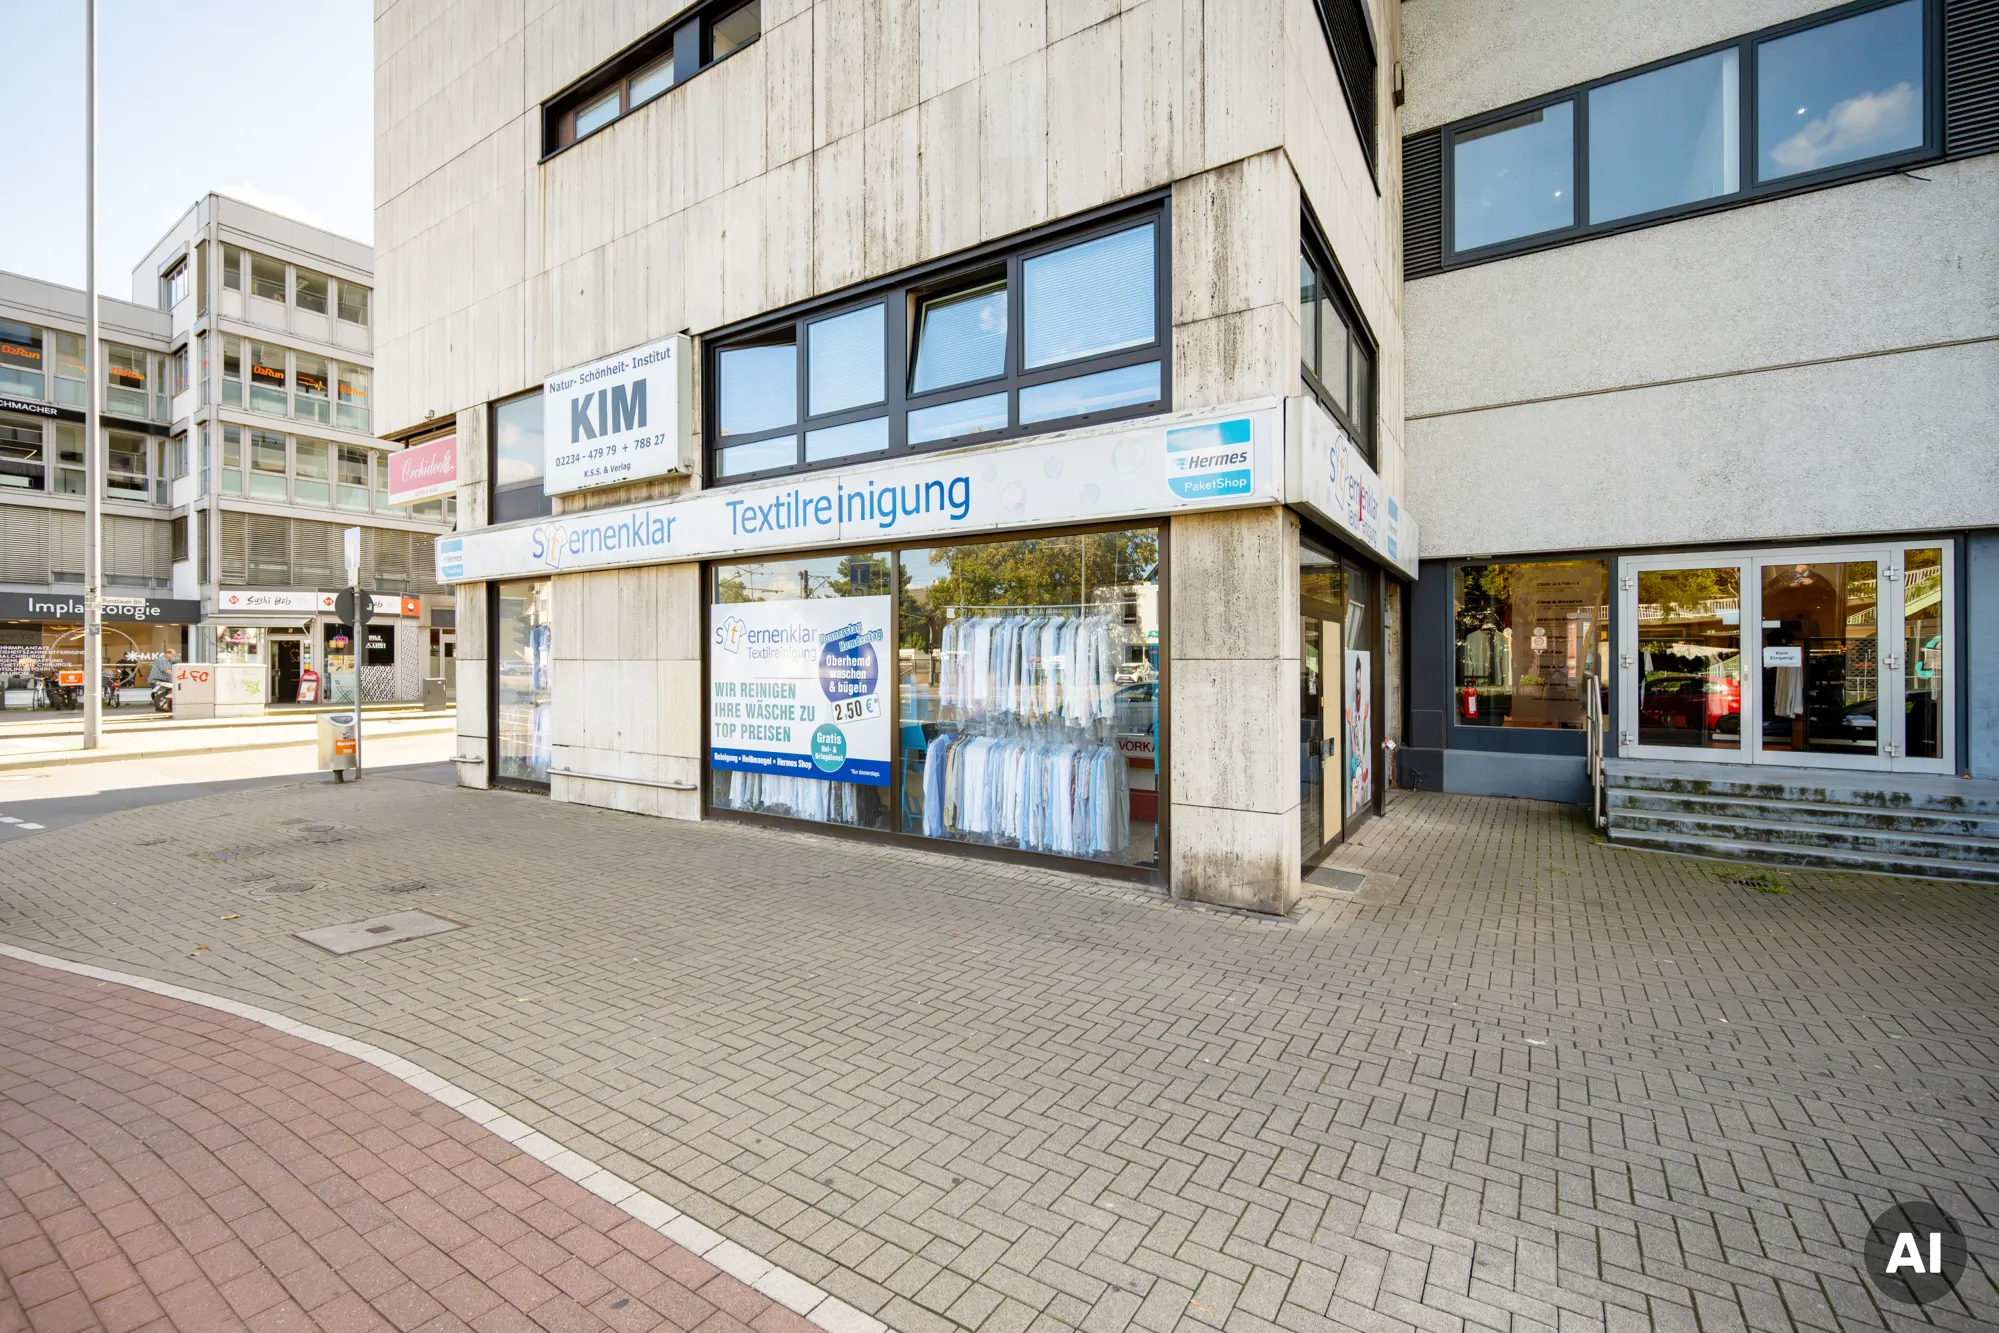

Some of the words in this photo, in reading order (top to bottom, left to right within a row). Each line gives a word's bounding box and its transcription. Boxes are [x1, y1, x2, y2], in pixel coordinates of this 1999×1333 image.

[549, 379, 577, 394] Natur-
[579, 361, 629, 385] Schönheit-
[632, 347, 671, 369] Institut
[571, 378, 647, 444] KIM
[556, 453, 580, 467] 02234
[588, 448, 604, 460] 479
[606, 445, 617, 457] 79
[622, 443, 629, 452] +
[634, 437, 651, 451] 788
[654, 433, 665, 446] 27
[1188, 450, 1248, 470] Hermes
[584, 467, 602, 478] K.S.S.
[603, 464, 609, 474] &
[610, 462, 631, 474] Verlag
[1184, 476, 1247, 493] PaketShop
[725, 476, 971, 536] Textilreinigung
[532, 511, 677, 562] Sternenklar
[246, 596, 271, 605] Sushi
[715, 624, 817, 646] Sternenklar
[819, 622, 863, 645] Donnerstag
[839, 628, 883, 652] Hemdentag
[747, 646, 816, 661] Textilreinigung
[826, 655, 871, 667] Oberhemd
[830, 667, 867, 679] waschen
[715, 681, 736, 698] WIR
[740, 682, 796, 699] REINIGEN
[829, 681, 836, 693] &
[838, 681, 868, 696] bügeln
[715, 702, 741, 718] IHRE
[745, 699, 795, 721] WÄSCHE
[800, 705, 815, 722] ZU
[835, 700, 863, 721] 2,50
[715, 723, 737, 739] TOP
[740, 724, 791, 743] PREISEN
[816, 732, 842, 745] Gratis
[714, 752, 738, 764] Reinigung
[777, 757, 797, 768] Hermes
[798, 759, 812, 770] Shop
[815, 752, 843, 763] Bringdienst
